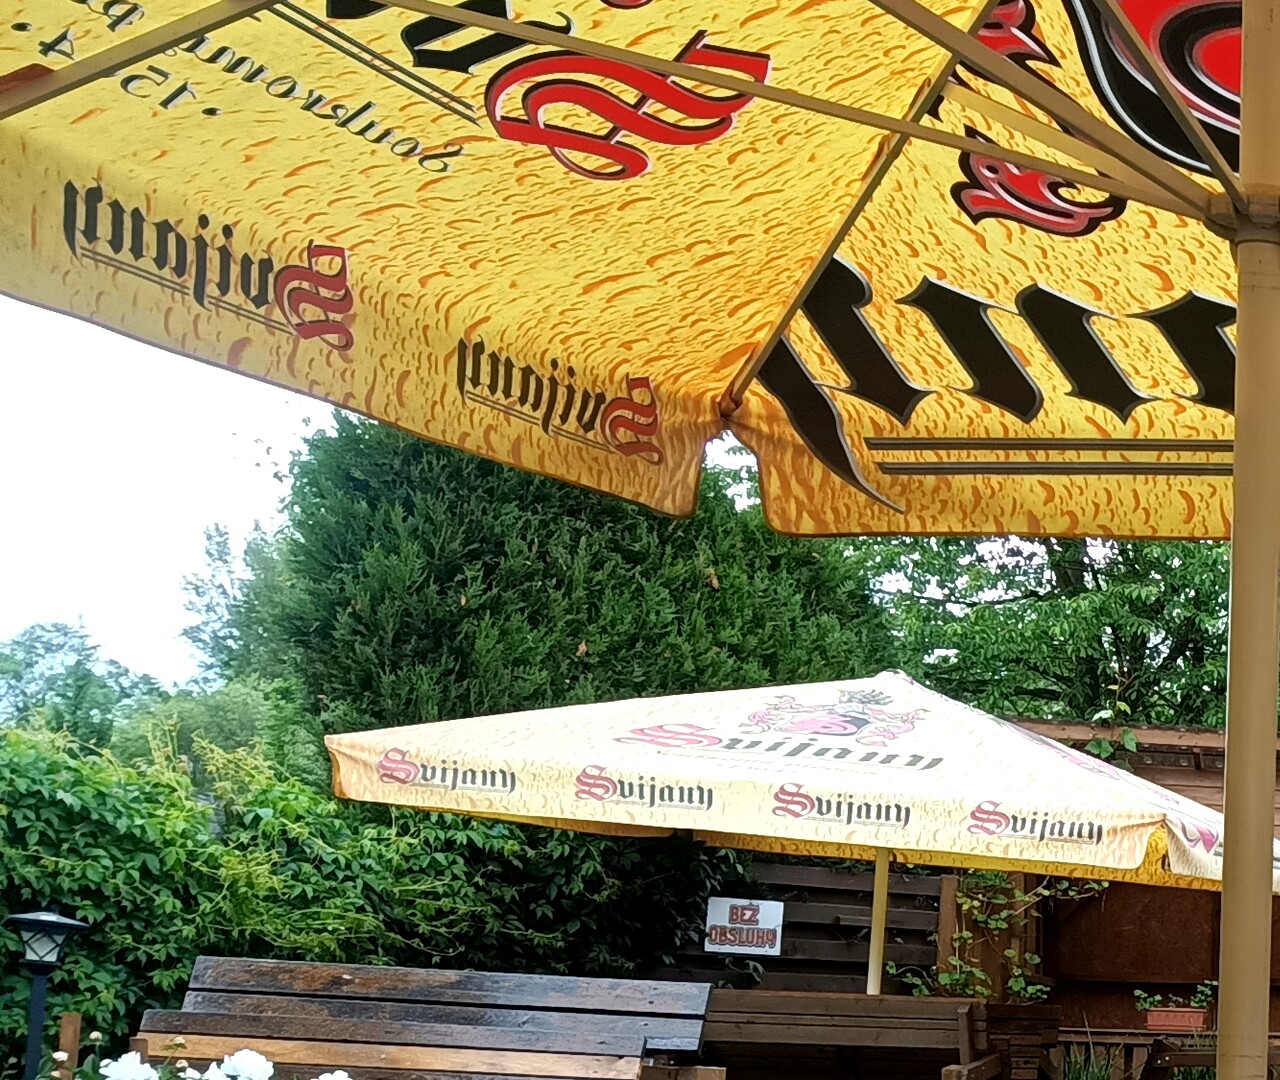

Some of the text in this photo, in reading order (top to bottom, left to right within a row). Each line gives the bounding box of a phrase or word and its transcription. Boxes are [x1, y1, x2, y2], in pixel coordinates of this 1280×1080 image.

[613, 723, 944, 771] Svijany
[376, 747, 517, 795] Svijany
[574, 764, 714, 811] Svijany
[771, 782, 911, 830] Svijany
[966, 800, 1103, 847] Svijany
[708, 924, 777, 949] OBSLUHY
[728, 904, 760, 926] BEZ
